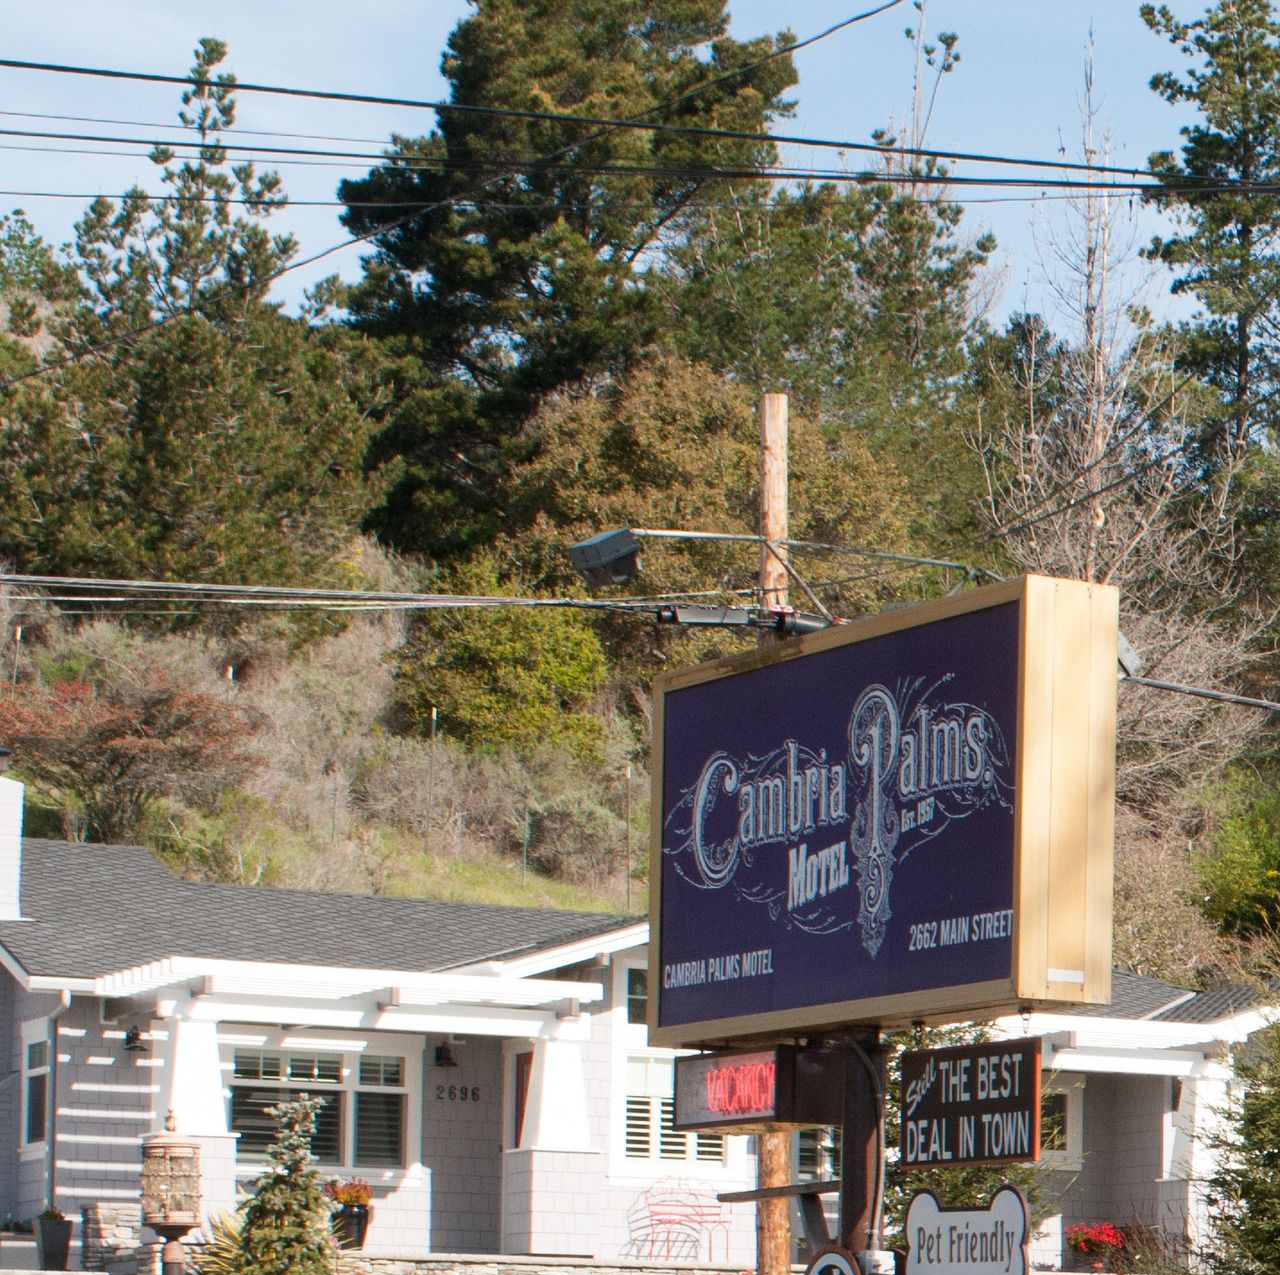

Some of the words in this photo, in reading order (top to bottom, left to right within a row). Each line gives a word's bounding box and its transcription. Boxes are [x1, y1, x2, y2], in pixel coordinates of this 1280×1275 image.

[693, 739, 849, 888] Cambria
[909, 921, 936, 951] 2662
[940, 916, 969, 946] MAIN
[971, 909, 1014, 941] STREET
[664, 959, 706, 989] CAMBRIA
[708, 954, 740, 982] PALMS
[742, 948, 774, 977] MOTEL
[435, 1084, 480, 1102] 2696
[906, 1057, 937, 1117] Still
[939, 1058, 971, 1104] THE
[977, 1053, 1023, 1100] BEST
[906, 1118, 952, 1163] DEAL
[959, 1115, 975, 1159] IN
[982, 1110, 1029, 1157] TOWN
[917, 1226, 942, 1264] Pet
[949, 1220, 1015, 1273] Friendly
